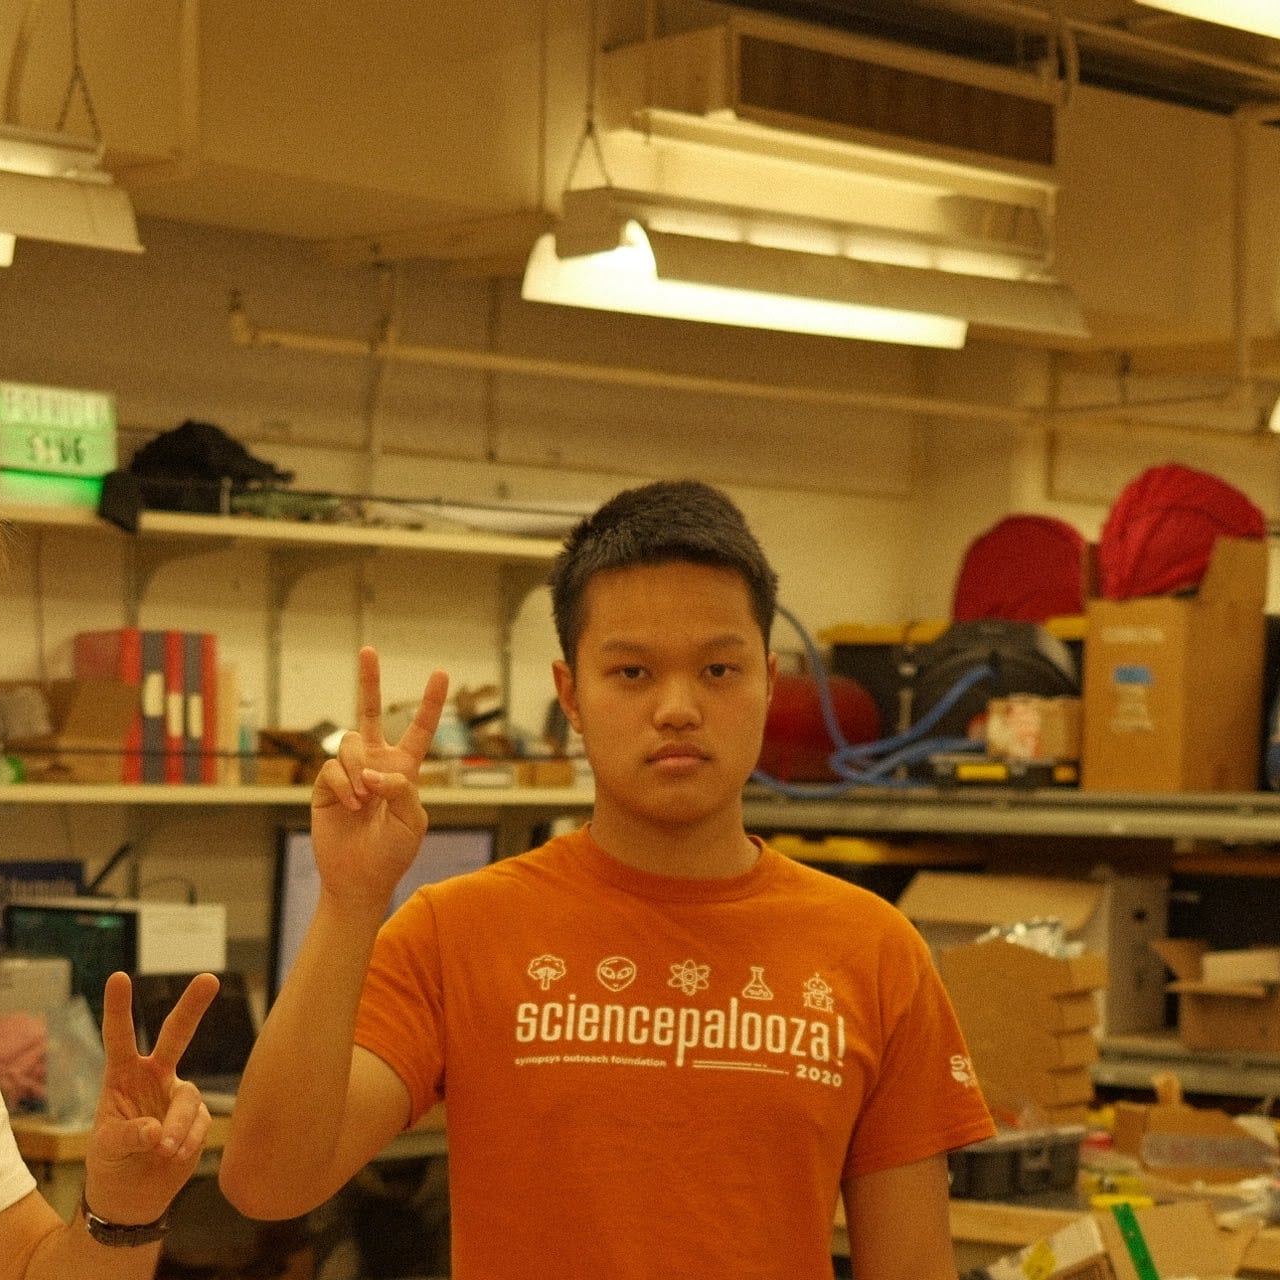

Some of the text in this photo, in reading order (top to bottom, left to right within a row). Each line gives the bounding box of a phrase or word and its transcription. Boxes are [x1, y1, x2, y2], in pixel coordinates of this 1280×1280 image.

[515, 993, 846, 1067] sciencepalooza!
[514, 1053, 667, 1068] synopsys outreach foundation
[795, 1063, 843, 1088] 2020
